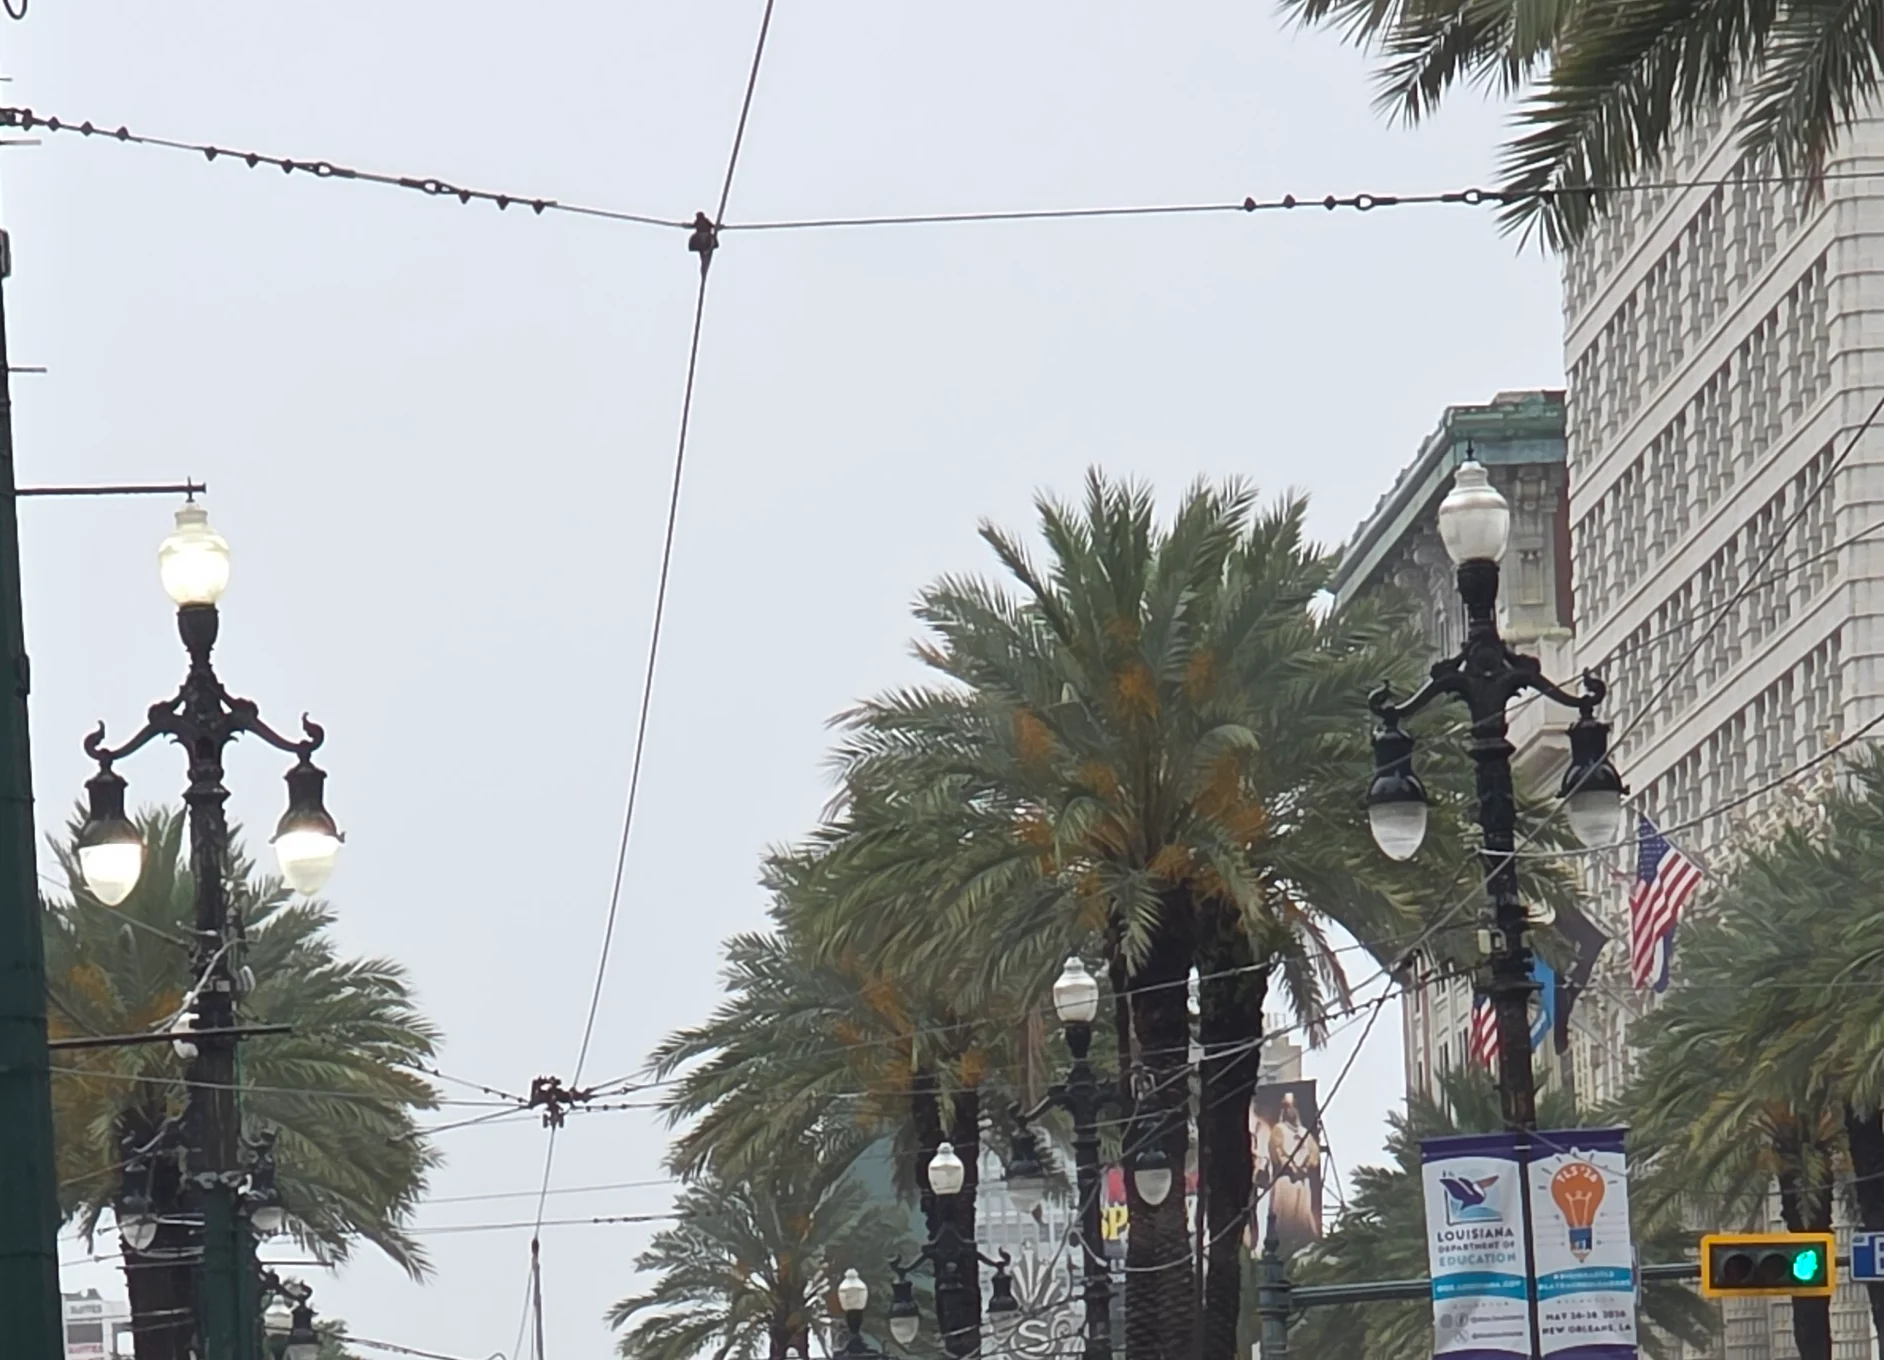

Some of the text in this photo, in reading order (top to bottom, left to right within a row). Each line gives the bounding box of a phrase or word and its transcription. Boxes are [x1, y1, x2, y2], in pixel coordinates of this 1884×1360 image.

[1437, 1227, 1514, 1242] LOUISIANA
[1438, 1240, 1515, 1254] DEPARTMENT OF
[1439, 1252, 1516, 1267] EDUCATION
[1546, 1311, 1567, 1320] MAY
[1542, 1326, 1564, 1335] NEW
[1619, 1322, 1631, 1331] LA
